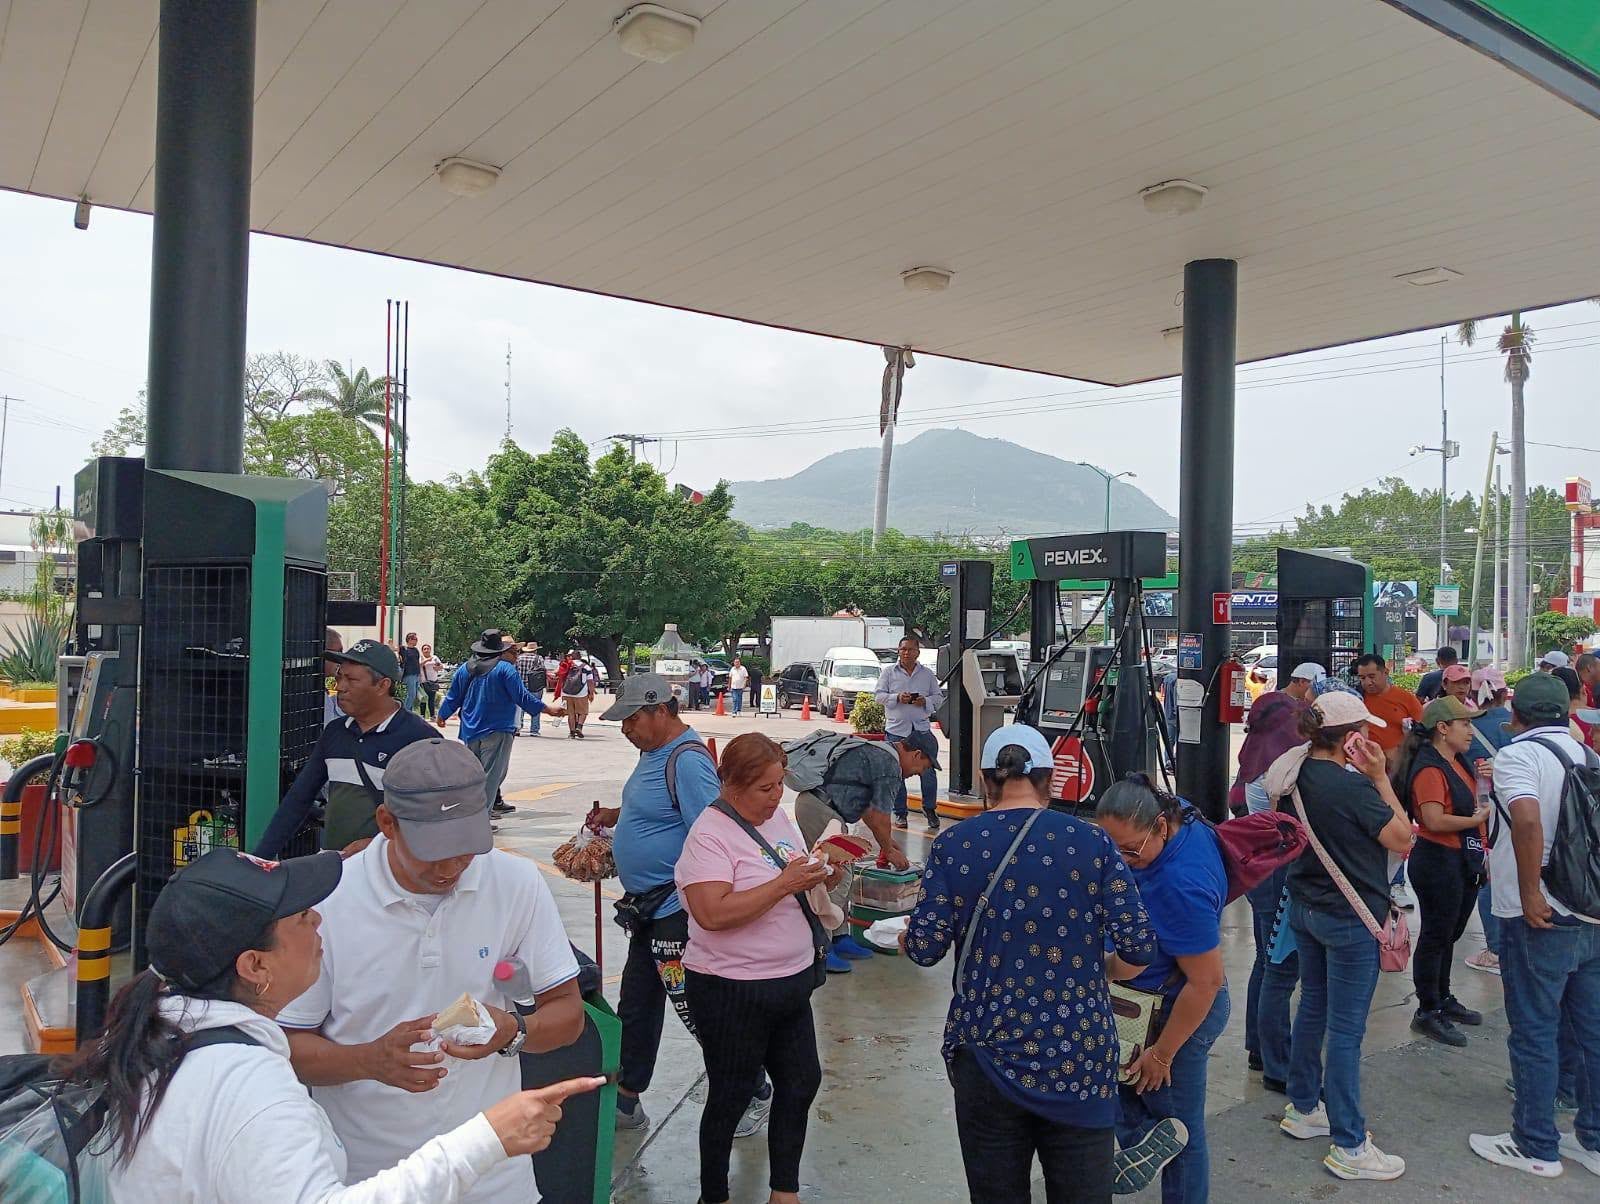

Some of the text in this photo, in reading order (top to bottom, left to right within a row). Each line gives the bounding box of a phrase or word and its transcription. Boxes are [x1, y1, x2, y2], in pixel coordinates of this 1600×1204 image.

[1018, 553, 1025, 566] 2
[1045, 548, 1103, 566] PEMEX
[1231, 594, 1278, 603] ENTO
[657, 941, 682, 949] WANT
[664, 948, 685, 956] MTV
